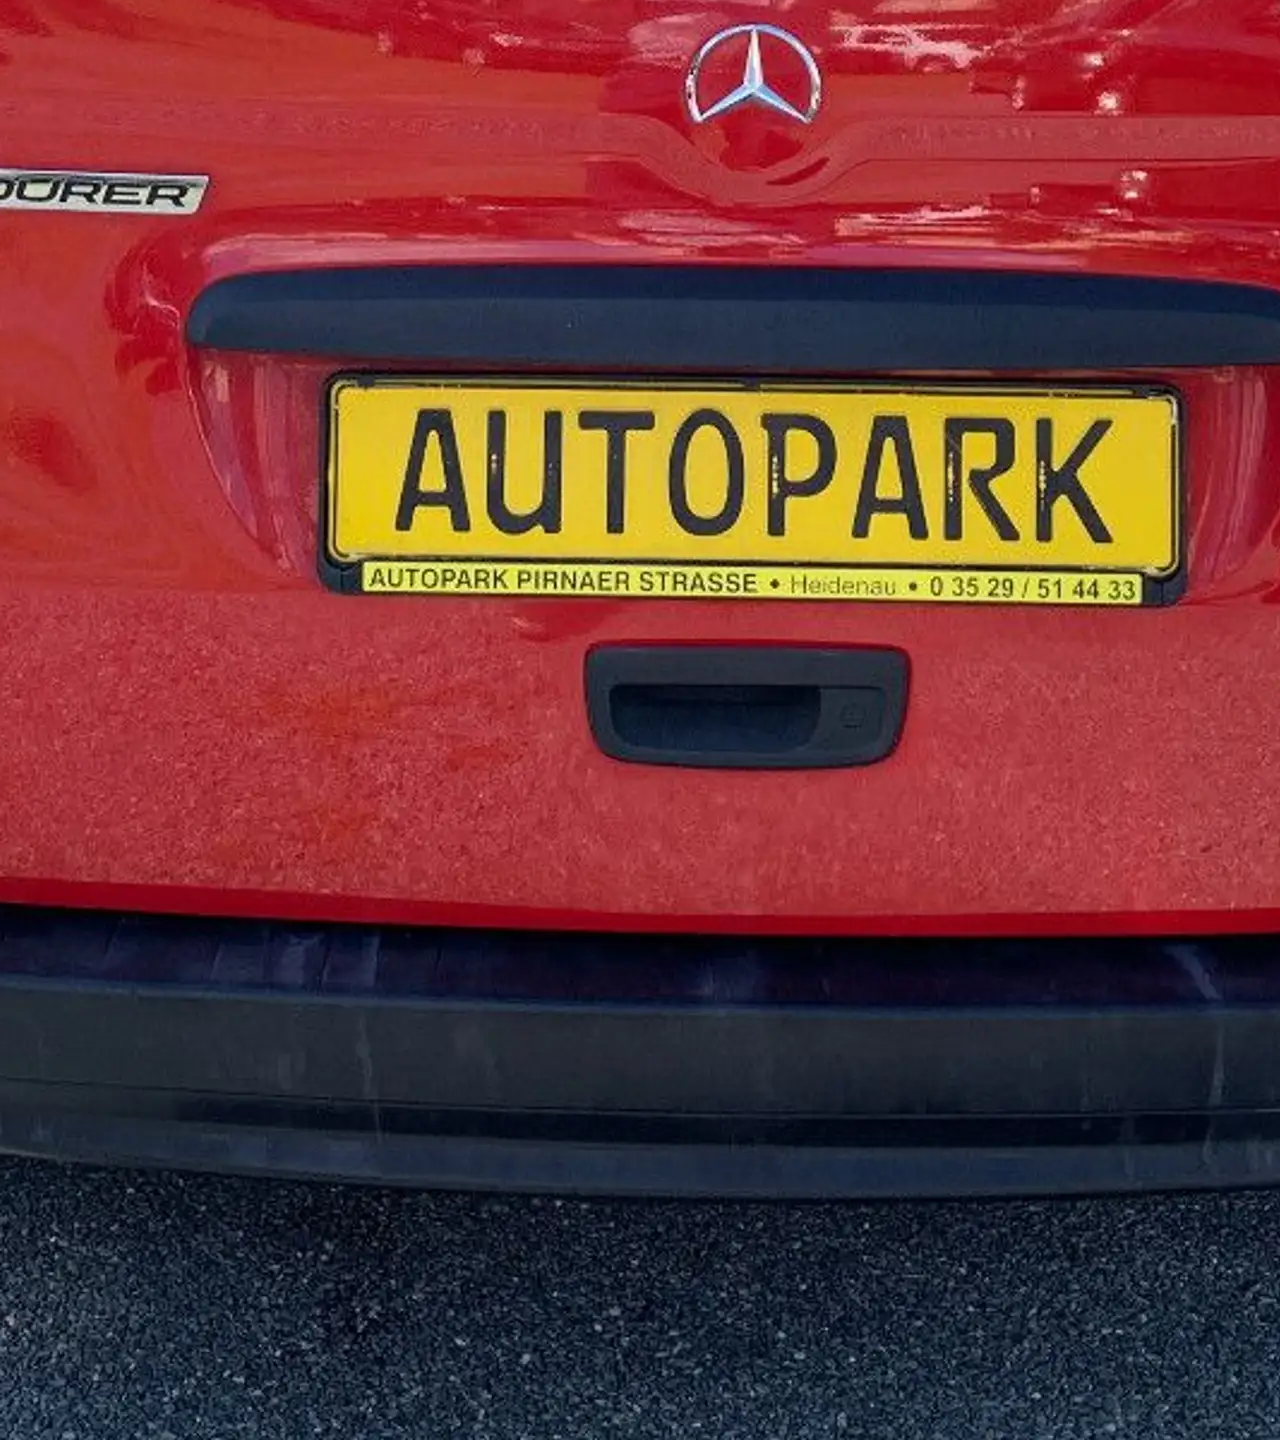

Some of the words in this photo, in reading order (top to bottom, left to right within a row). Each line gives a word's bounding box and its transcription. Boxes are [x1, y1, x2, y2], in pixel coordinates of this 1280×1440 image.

[394, 407, 1114, 544] AUTOPARK
[368, 567, 508, 590] AUTOPARK
[516, 569, 630, 592] PIRNAER
[639, 570, 757, 593] STRASSE
[790, 574, 897, 597] Heidenau
[929, 575, 944, 597] 0
[951, 575, 980, 598] 35
[987, 577, 1014, 599] 29
[1037, 577, 1062, 600] 51
[1071, 578, 1100, 600] 44
[1107, 579, 1136, 602] 33
